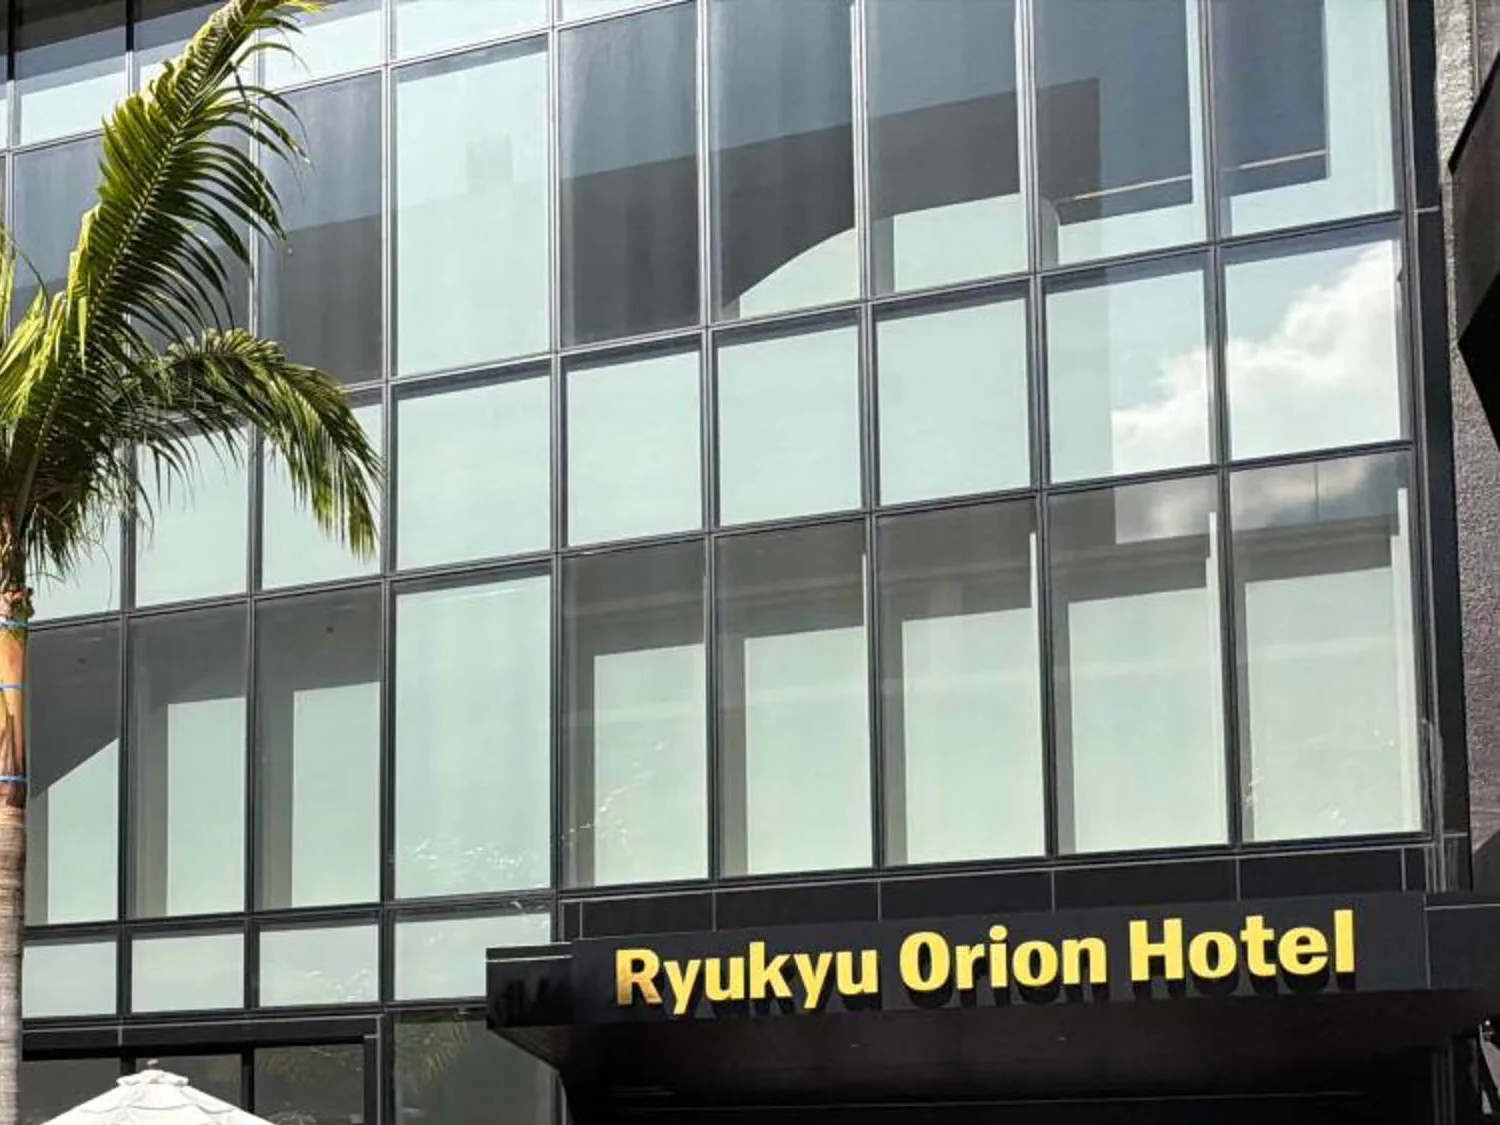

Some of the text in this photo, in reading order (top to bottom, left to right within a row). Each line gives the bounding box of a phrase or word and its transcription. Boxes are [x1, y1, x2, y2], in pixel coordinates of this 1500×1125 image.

[615, 909, 1355, 1015] Ryukyu Orion Hotel
